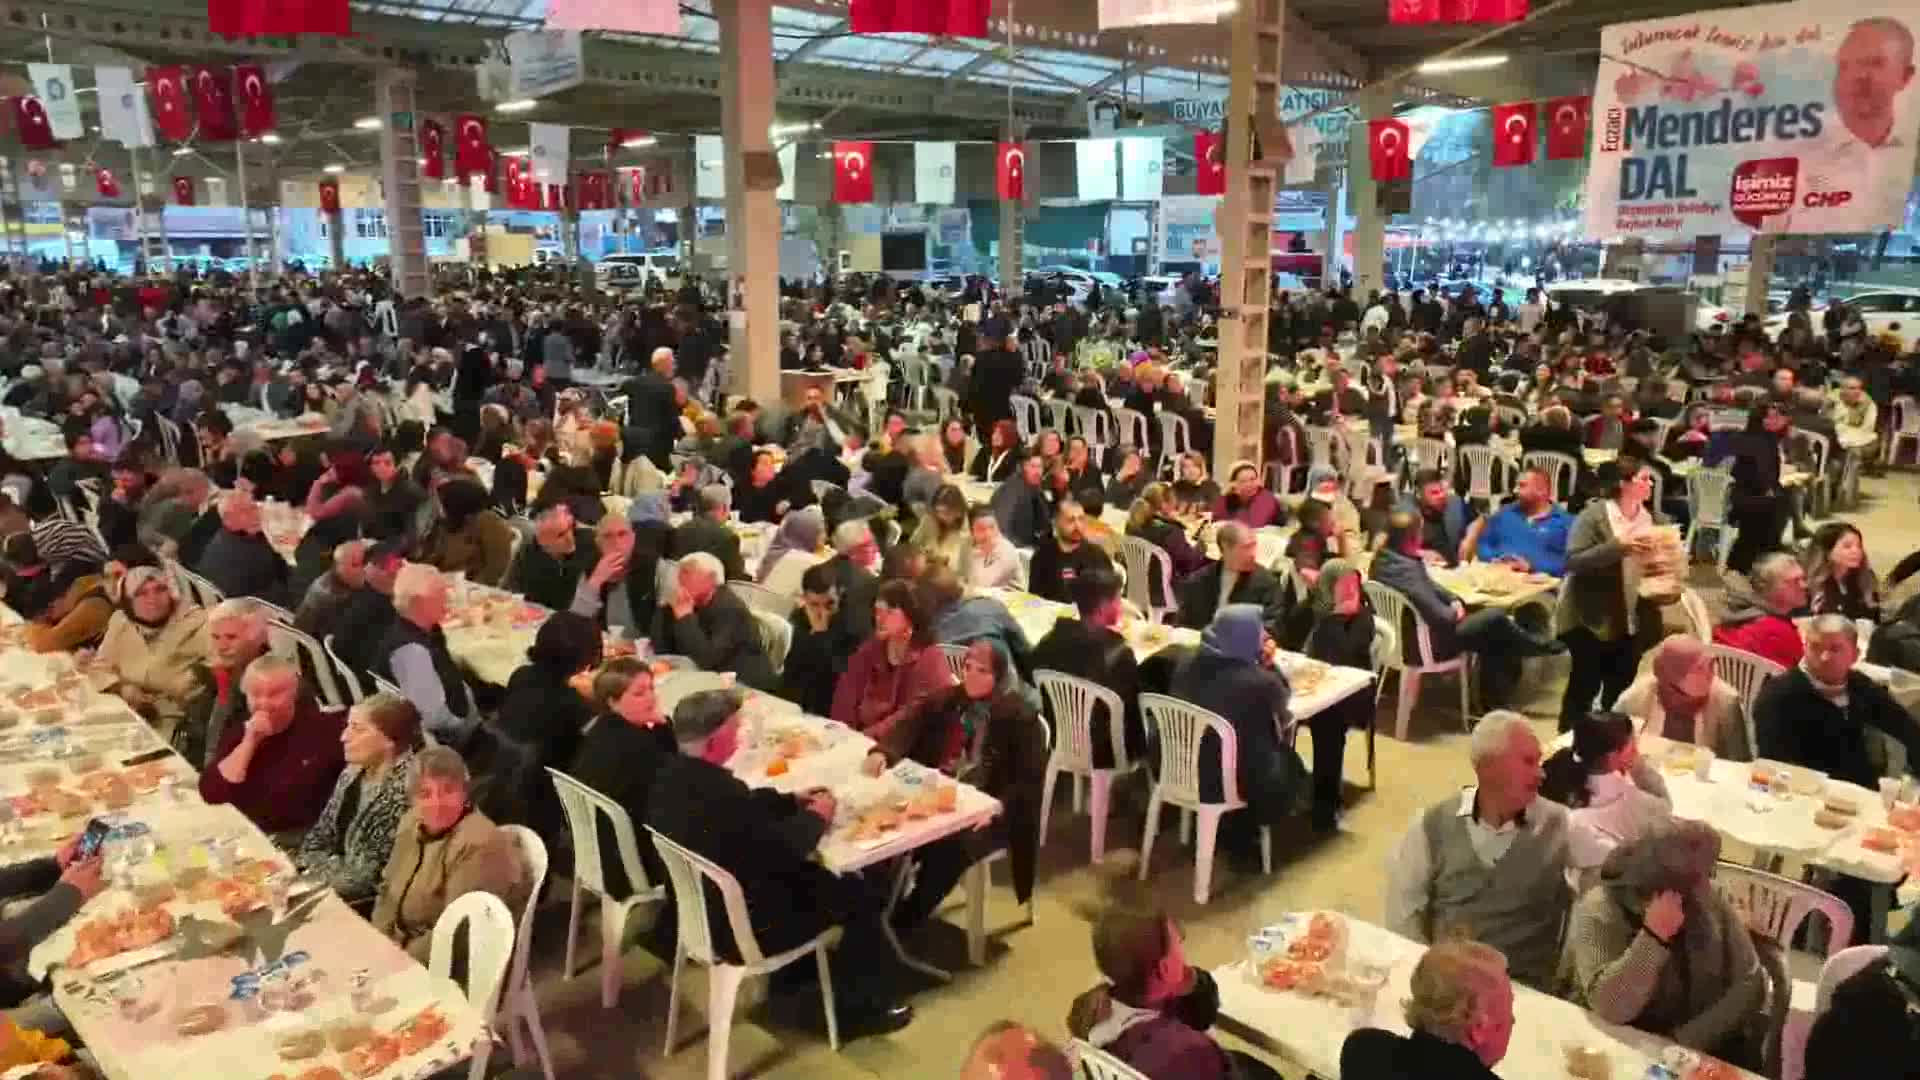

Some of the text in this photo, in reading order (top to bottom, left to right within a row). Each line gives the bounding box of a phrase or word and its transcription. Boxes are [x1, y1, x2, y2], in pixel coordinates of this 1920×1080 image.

[1622, 98, 1825, 152] Menderes
[1618, 153, 1698, 200] DAL
[1803, 190, 1853, 208] CHP
